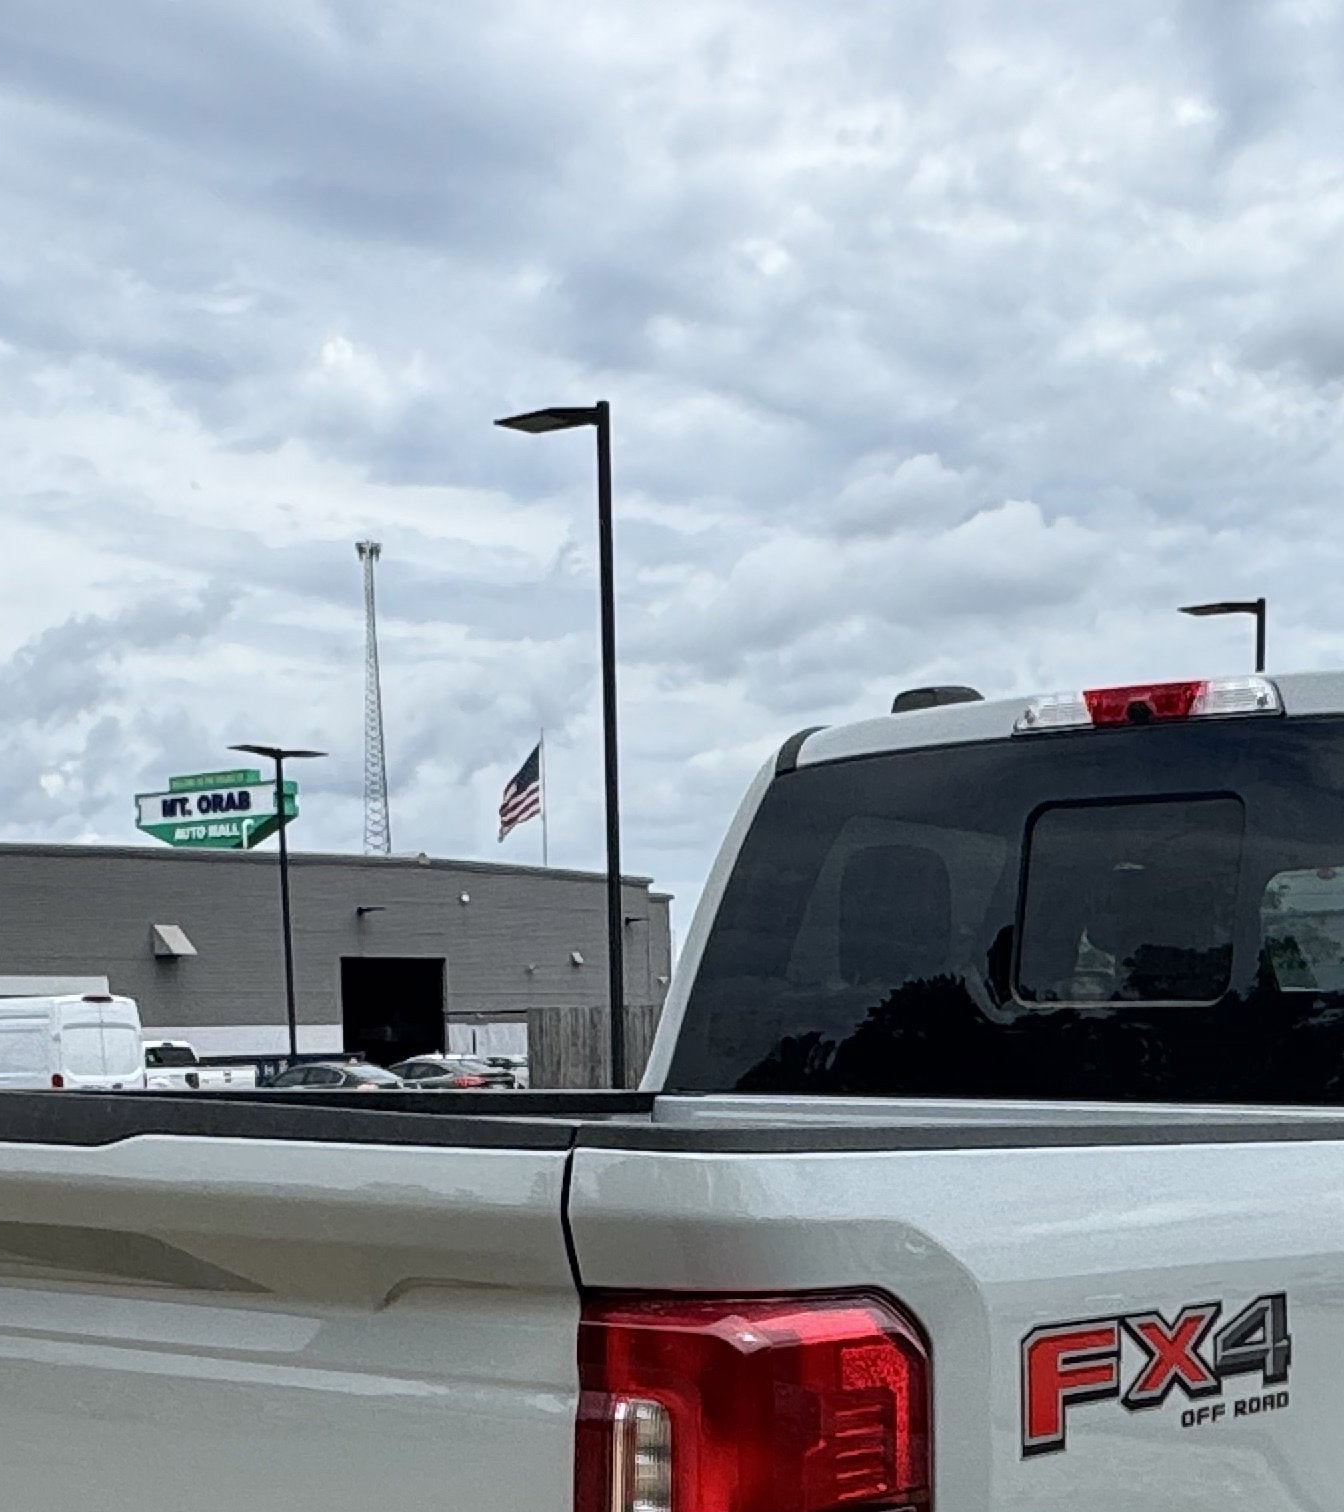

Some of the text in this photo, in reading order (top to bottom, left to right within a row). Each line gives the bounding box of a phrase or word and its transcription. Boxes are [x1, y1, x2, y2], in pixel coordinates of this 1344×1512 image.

[162, 790, 251, 818] MT. ORAB
[174, 823, 240, 840] AUTO MALL
[1019, 1290, 1292, 1460] FX4
[1180, 1390, 1290, 1428] OFF ROAD
